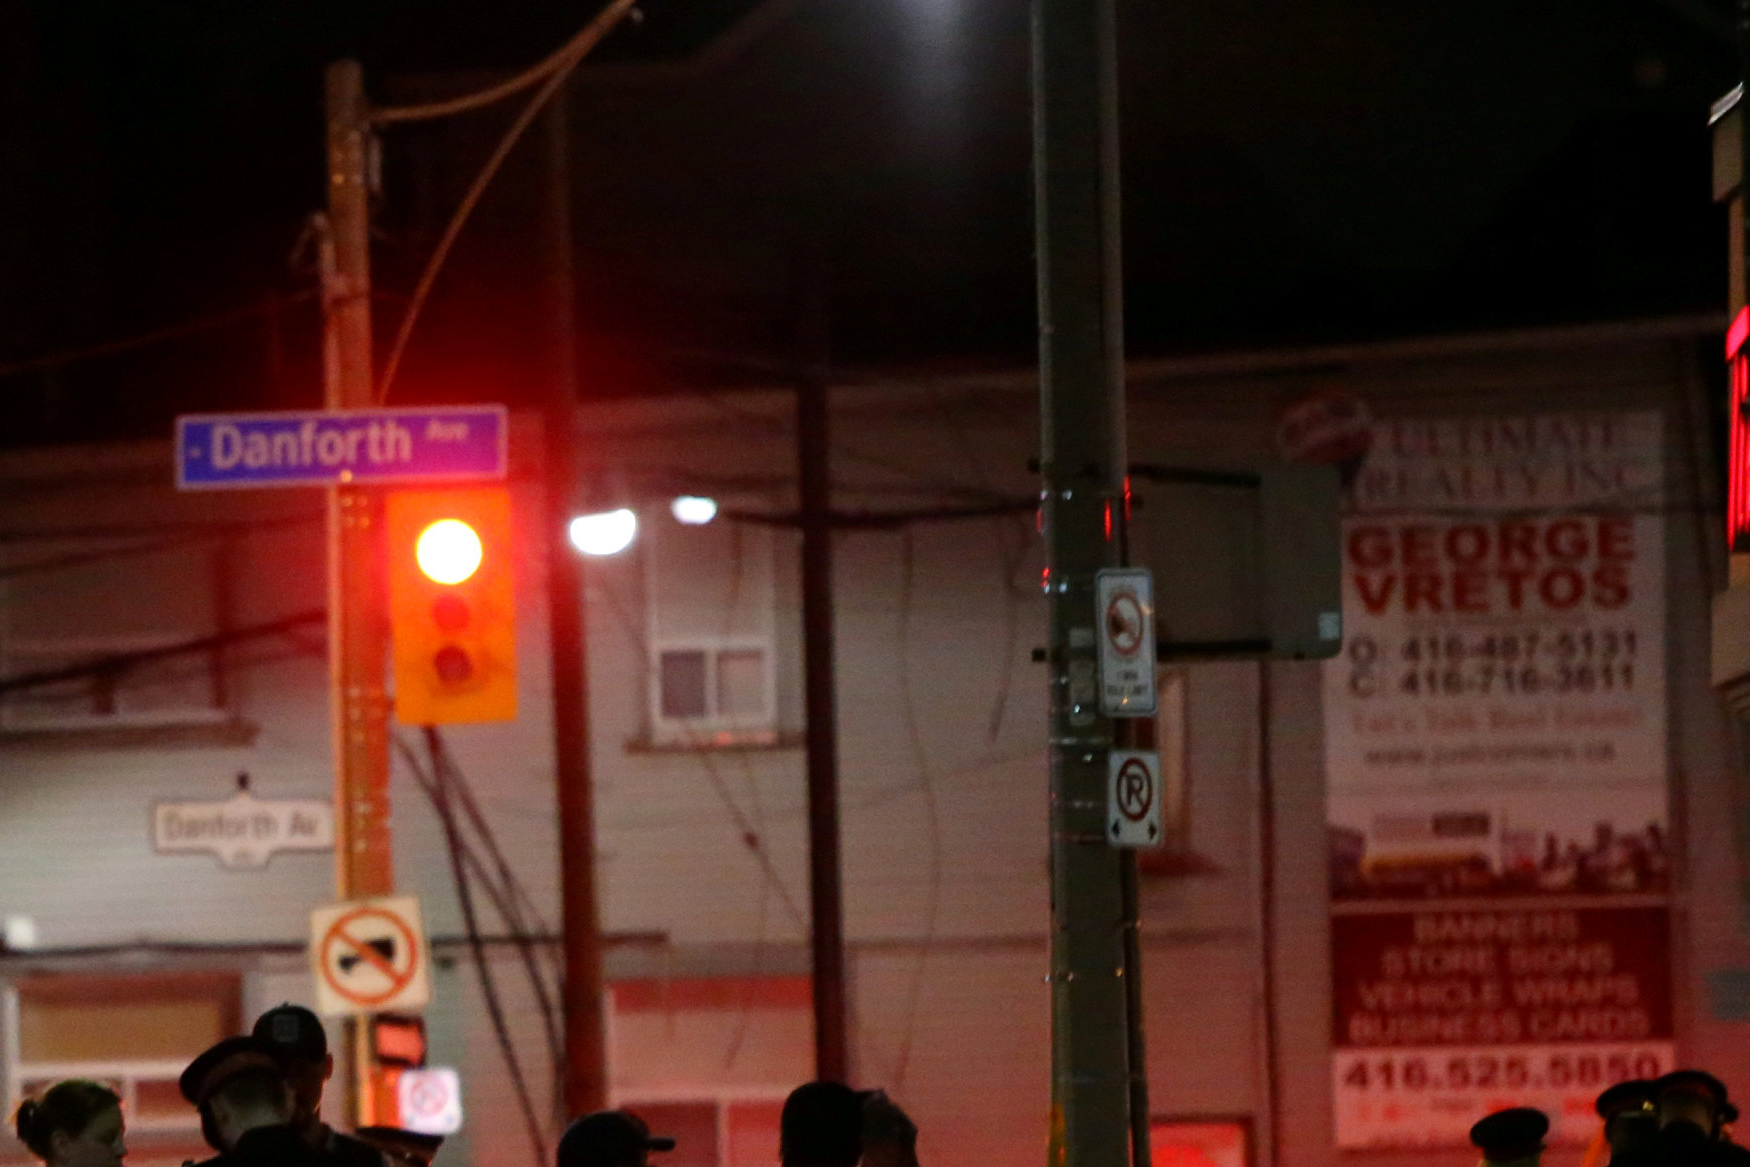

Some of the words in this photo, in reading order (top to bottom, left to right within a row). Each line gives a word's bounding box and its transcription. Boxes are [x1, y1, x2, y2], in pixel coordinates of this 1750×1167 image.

[211, 421, 413, 470] Danforth
[426, 420, 470, 443] Ave
[1348, 518, 1635, 567] GEORGE
[1352, 564, 1631, 614] VRETOS
[1413, 911, 1580, 942] BANNERS
[1381, 943, 1497, 978] STORE
[1507, 941, 1614, 974] SIGNS
[1357, 975, 1504, 1010] VEHICLE
[1512, 972, 1641, 1006] WRAPS
[1348, 1009, 1523, 1044] BUSINESS
[1530, 1006, 1651, 1039] CARDS
[1345, 1055, 1660, 1091] 416.525.5850
